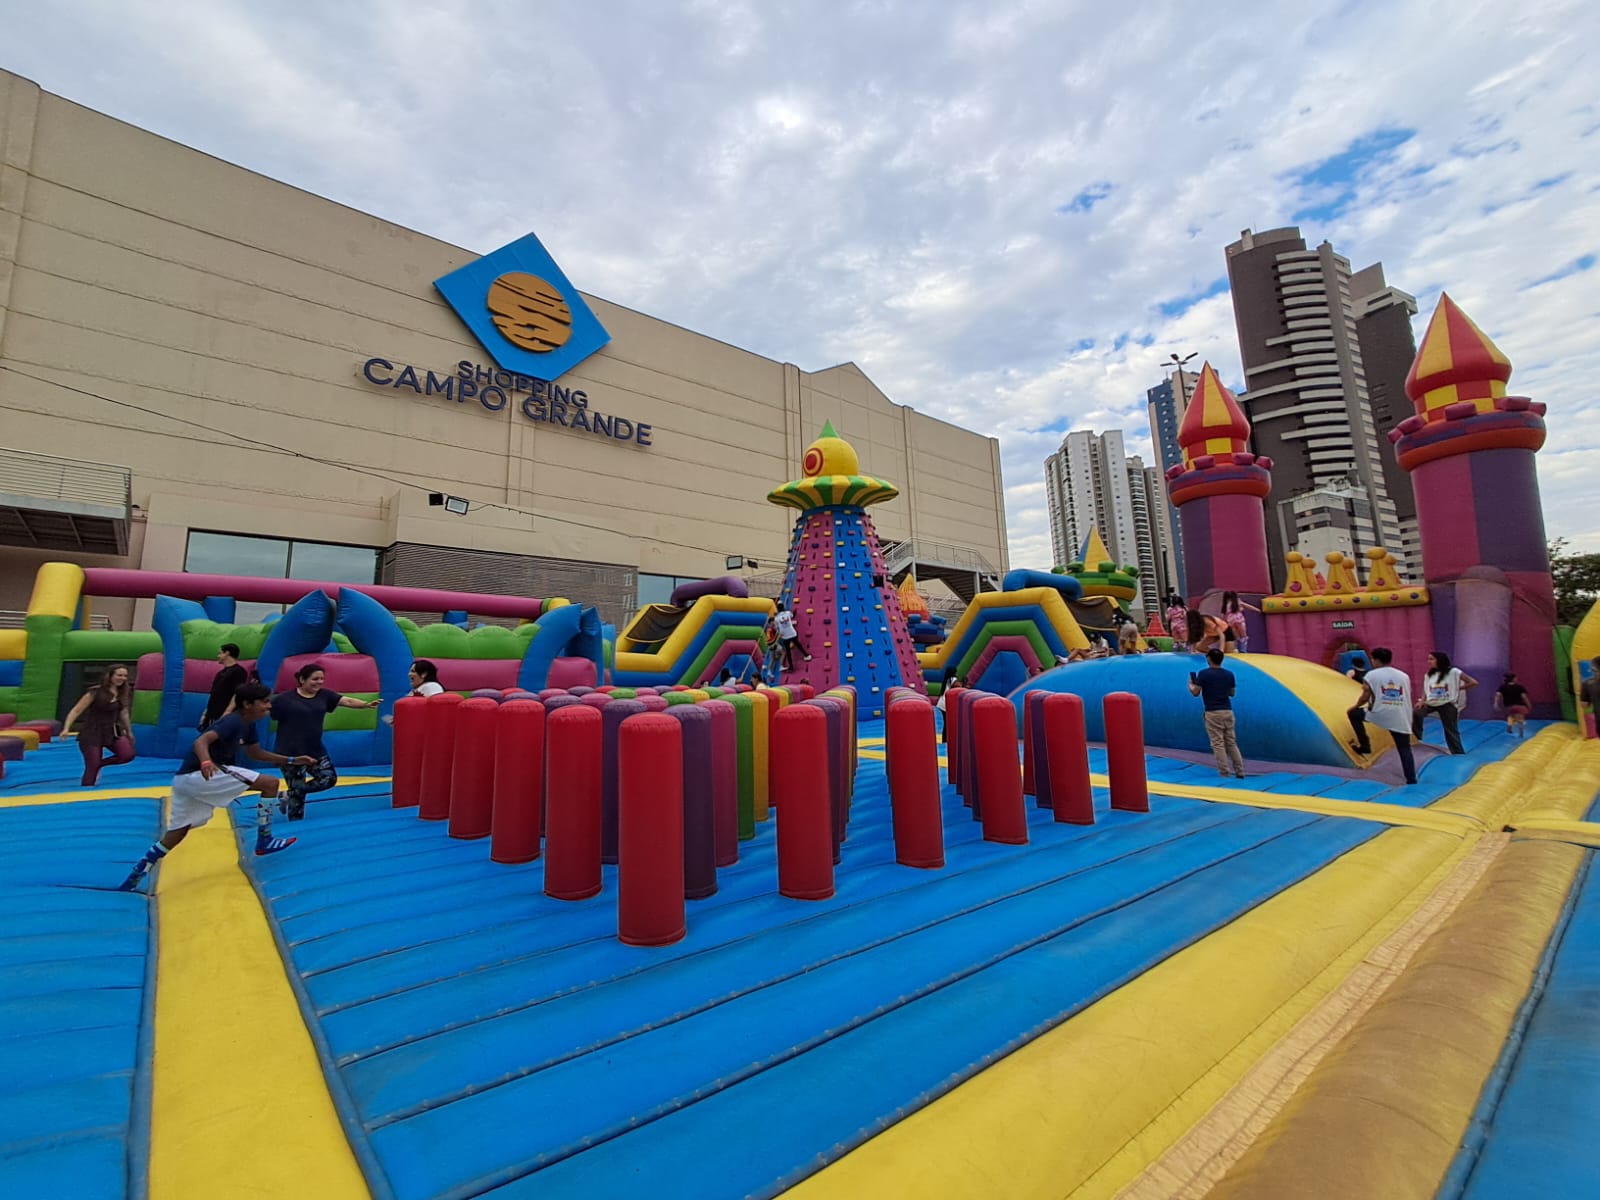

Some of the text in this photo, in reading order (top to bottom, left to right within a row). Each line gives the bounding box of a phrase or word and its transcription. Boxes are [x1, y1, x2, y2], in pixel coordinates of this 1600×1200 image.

[363, 357, 652, 446] CAMPO GRANDE
[458, 360, 588, 408] SHOPPING
